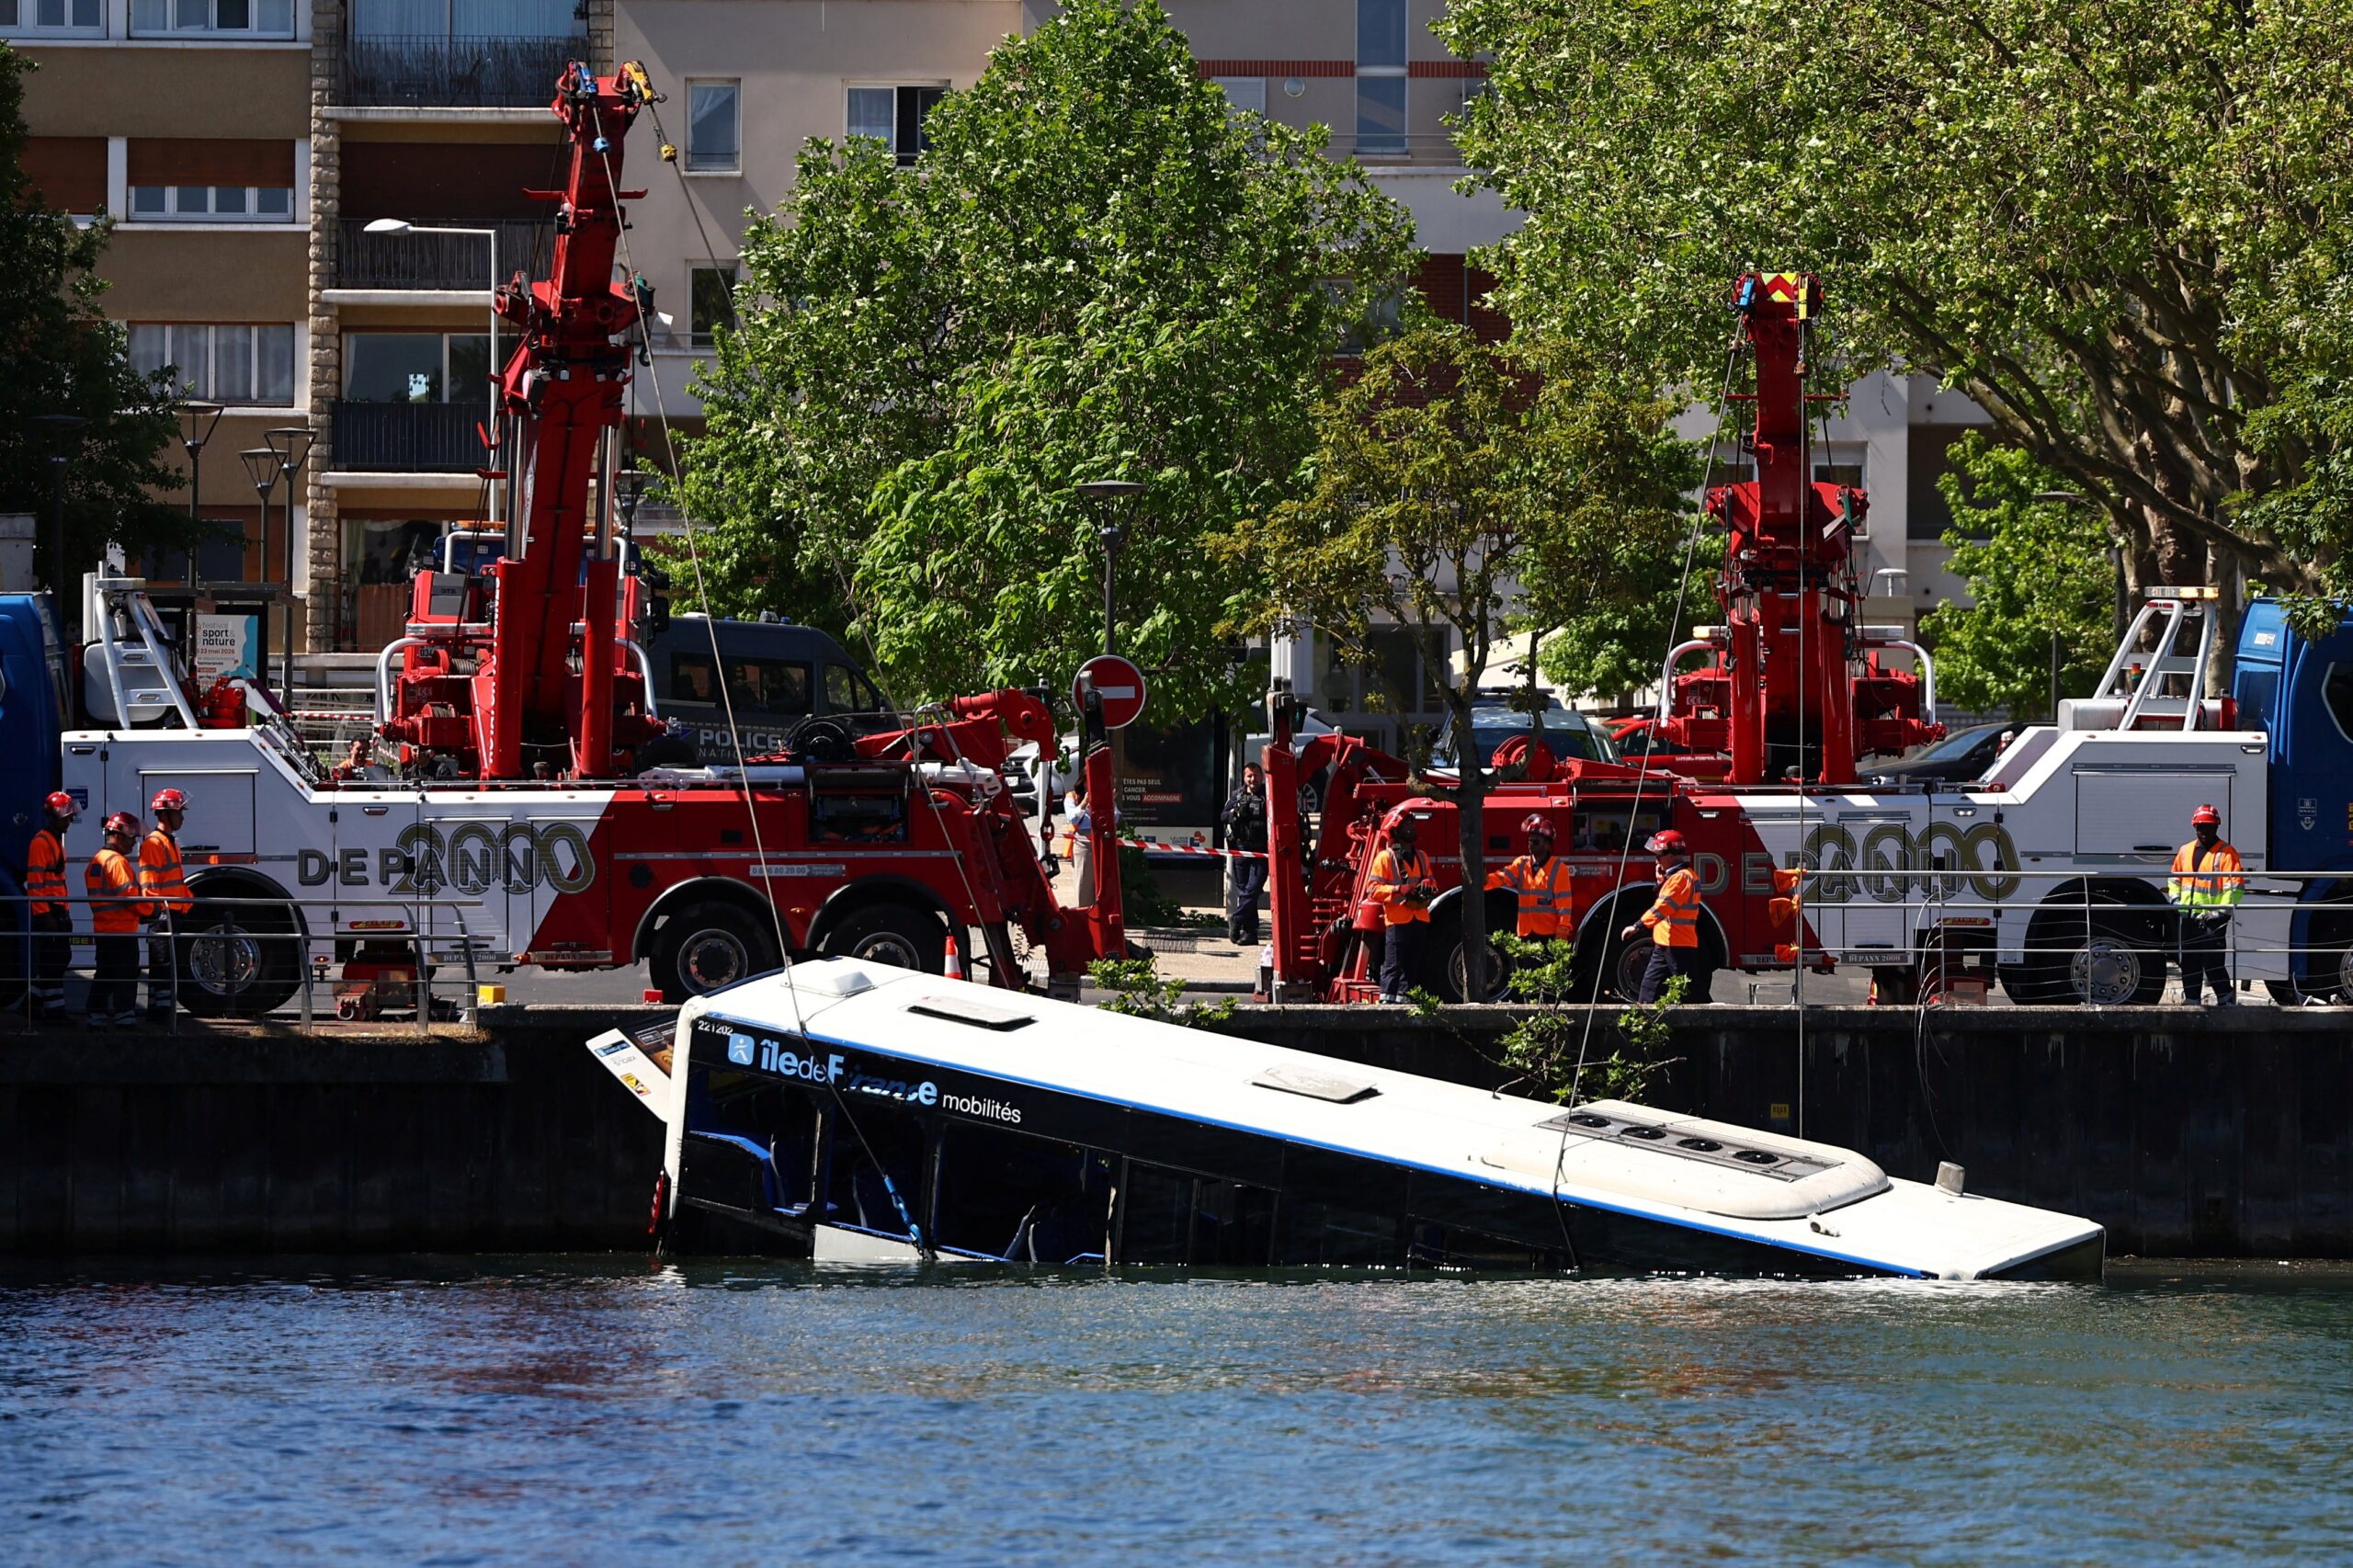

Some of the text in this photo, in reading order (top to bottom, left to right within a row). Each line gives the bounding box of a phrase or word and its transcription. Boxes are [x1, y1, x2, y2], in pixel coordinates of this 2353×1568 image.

[202, 629, 229, 638] sport
[202, 638, 235, 646] nature
[699, 729, 781, 749] POLICE
[297, 847, 534, 886] DEPANN
[388, 823, 596, 895] 2000
[1802, 822, 2021, 903] 2000
[477, 953, 496, 961] 2000
[1848, 953, 1901, 962] DEPANN 2000
[698, 1020, 733, 1036] 221202
[942, 1094, 1021, 1123] mobilités
